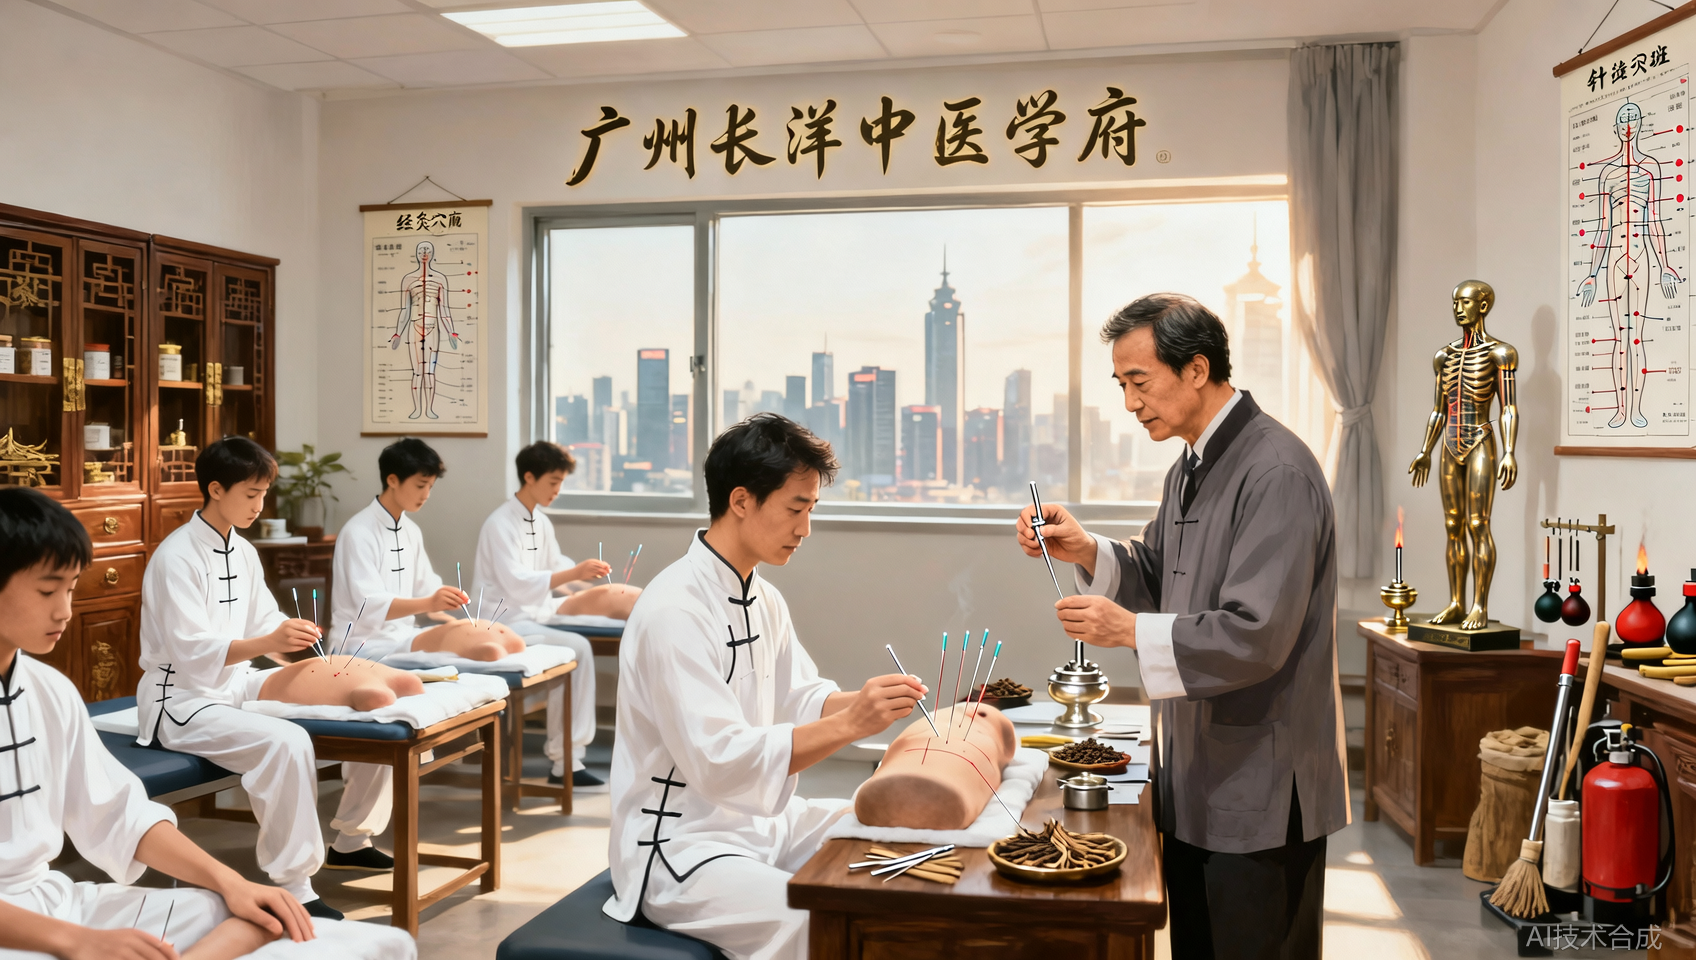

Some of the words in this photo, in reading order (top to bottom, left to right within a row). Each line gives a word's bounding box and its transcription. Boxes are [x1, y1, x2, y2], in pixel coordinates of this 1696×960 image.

[566, 86, 1147, 187] 广州长洋中医学府
